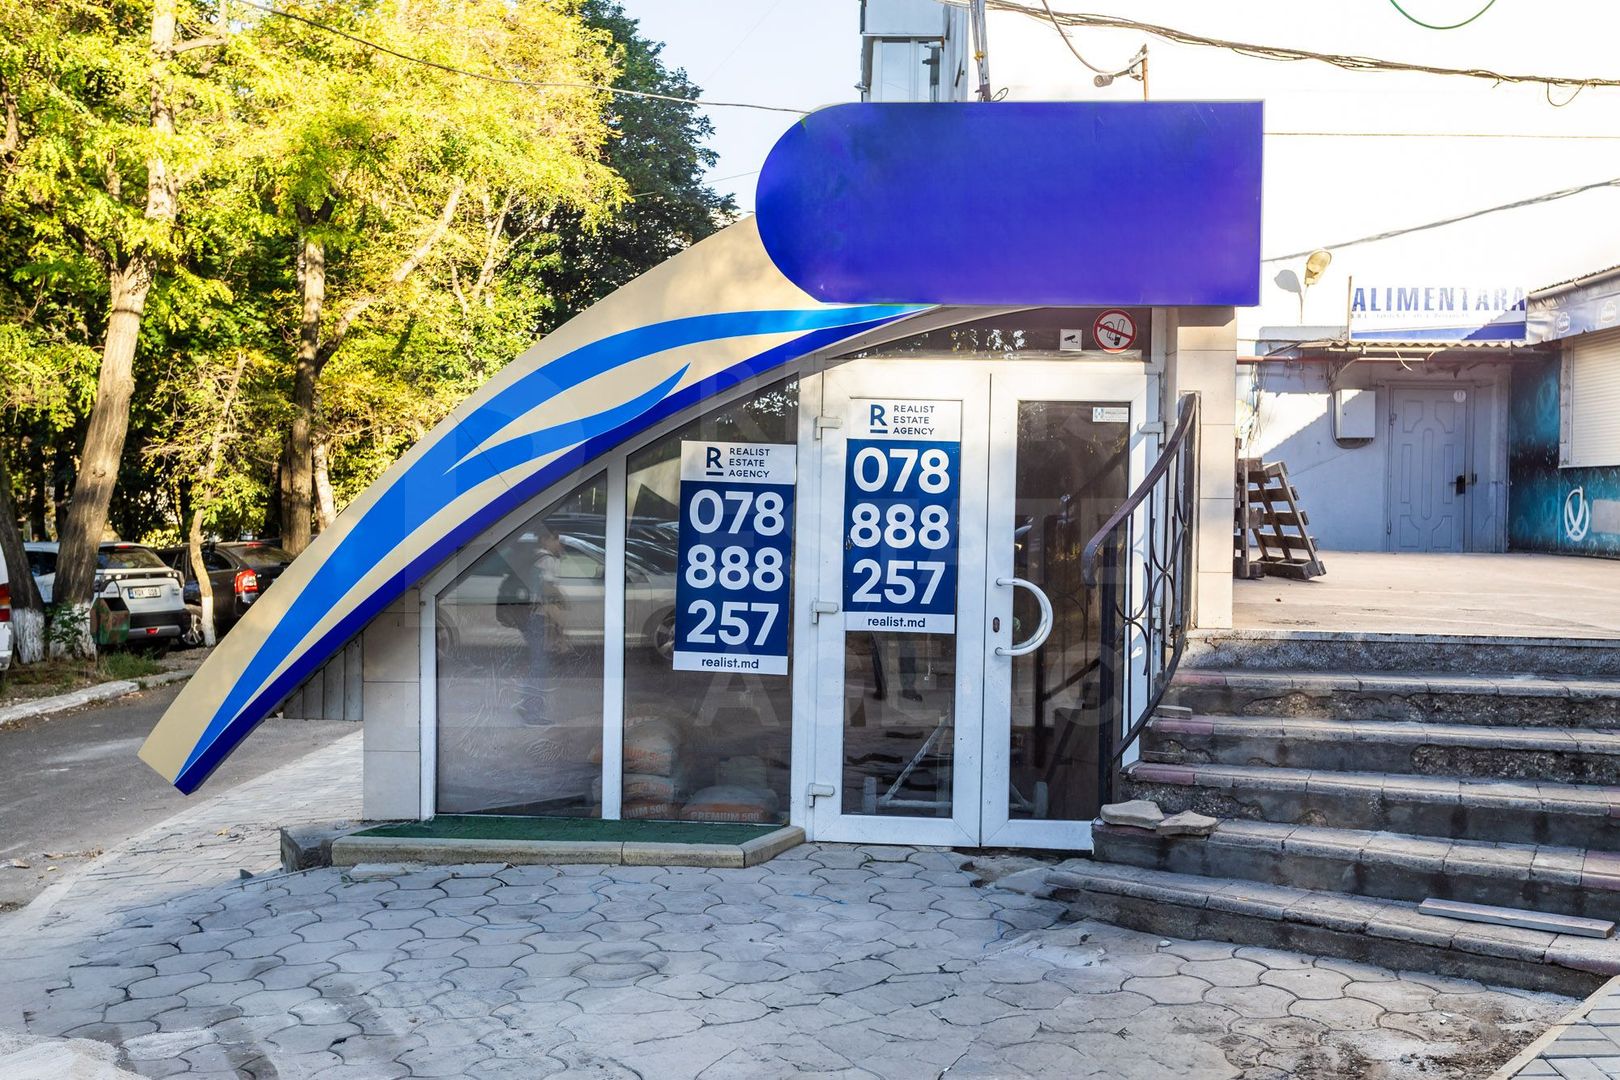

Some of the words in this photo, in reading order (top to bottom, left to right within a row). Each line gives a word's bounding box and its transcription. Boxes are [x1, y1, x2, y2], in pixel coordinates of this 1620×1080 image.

[870, 404, 887, 426] R
[893, 405, 935, 413] REALIST
[893, 416, 930, 424] ESTATE
[893, 427, 935, 435] AGENCY
[706, 447, 723, 469] R
[729, 448, 770, 457] REALIST
[729, 458, 765, 468] ESTATE
[853, 447, 950, 494] 078
[728, 469, 770, 478] AGENCY
[689, 489, 785, 536] 078
[850, 502, 950, 550] 888
[685, 544, 784, 592] 888
[852, 558, 946, 604] 257
[686, 599, 779, 646] 257
[867, 616, 925, 628] realist.md
[701, 657, 759, 670] realist.md
